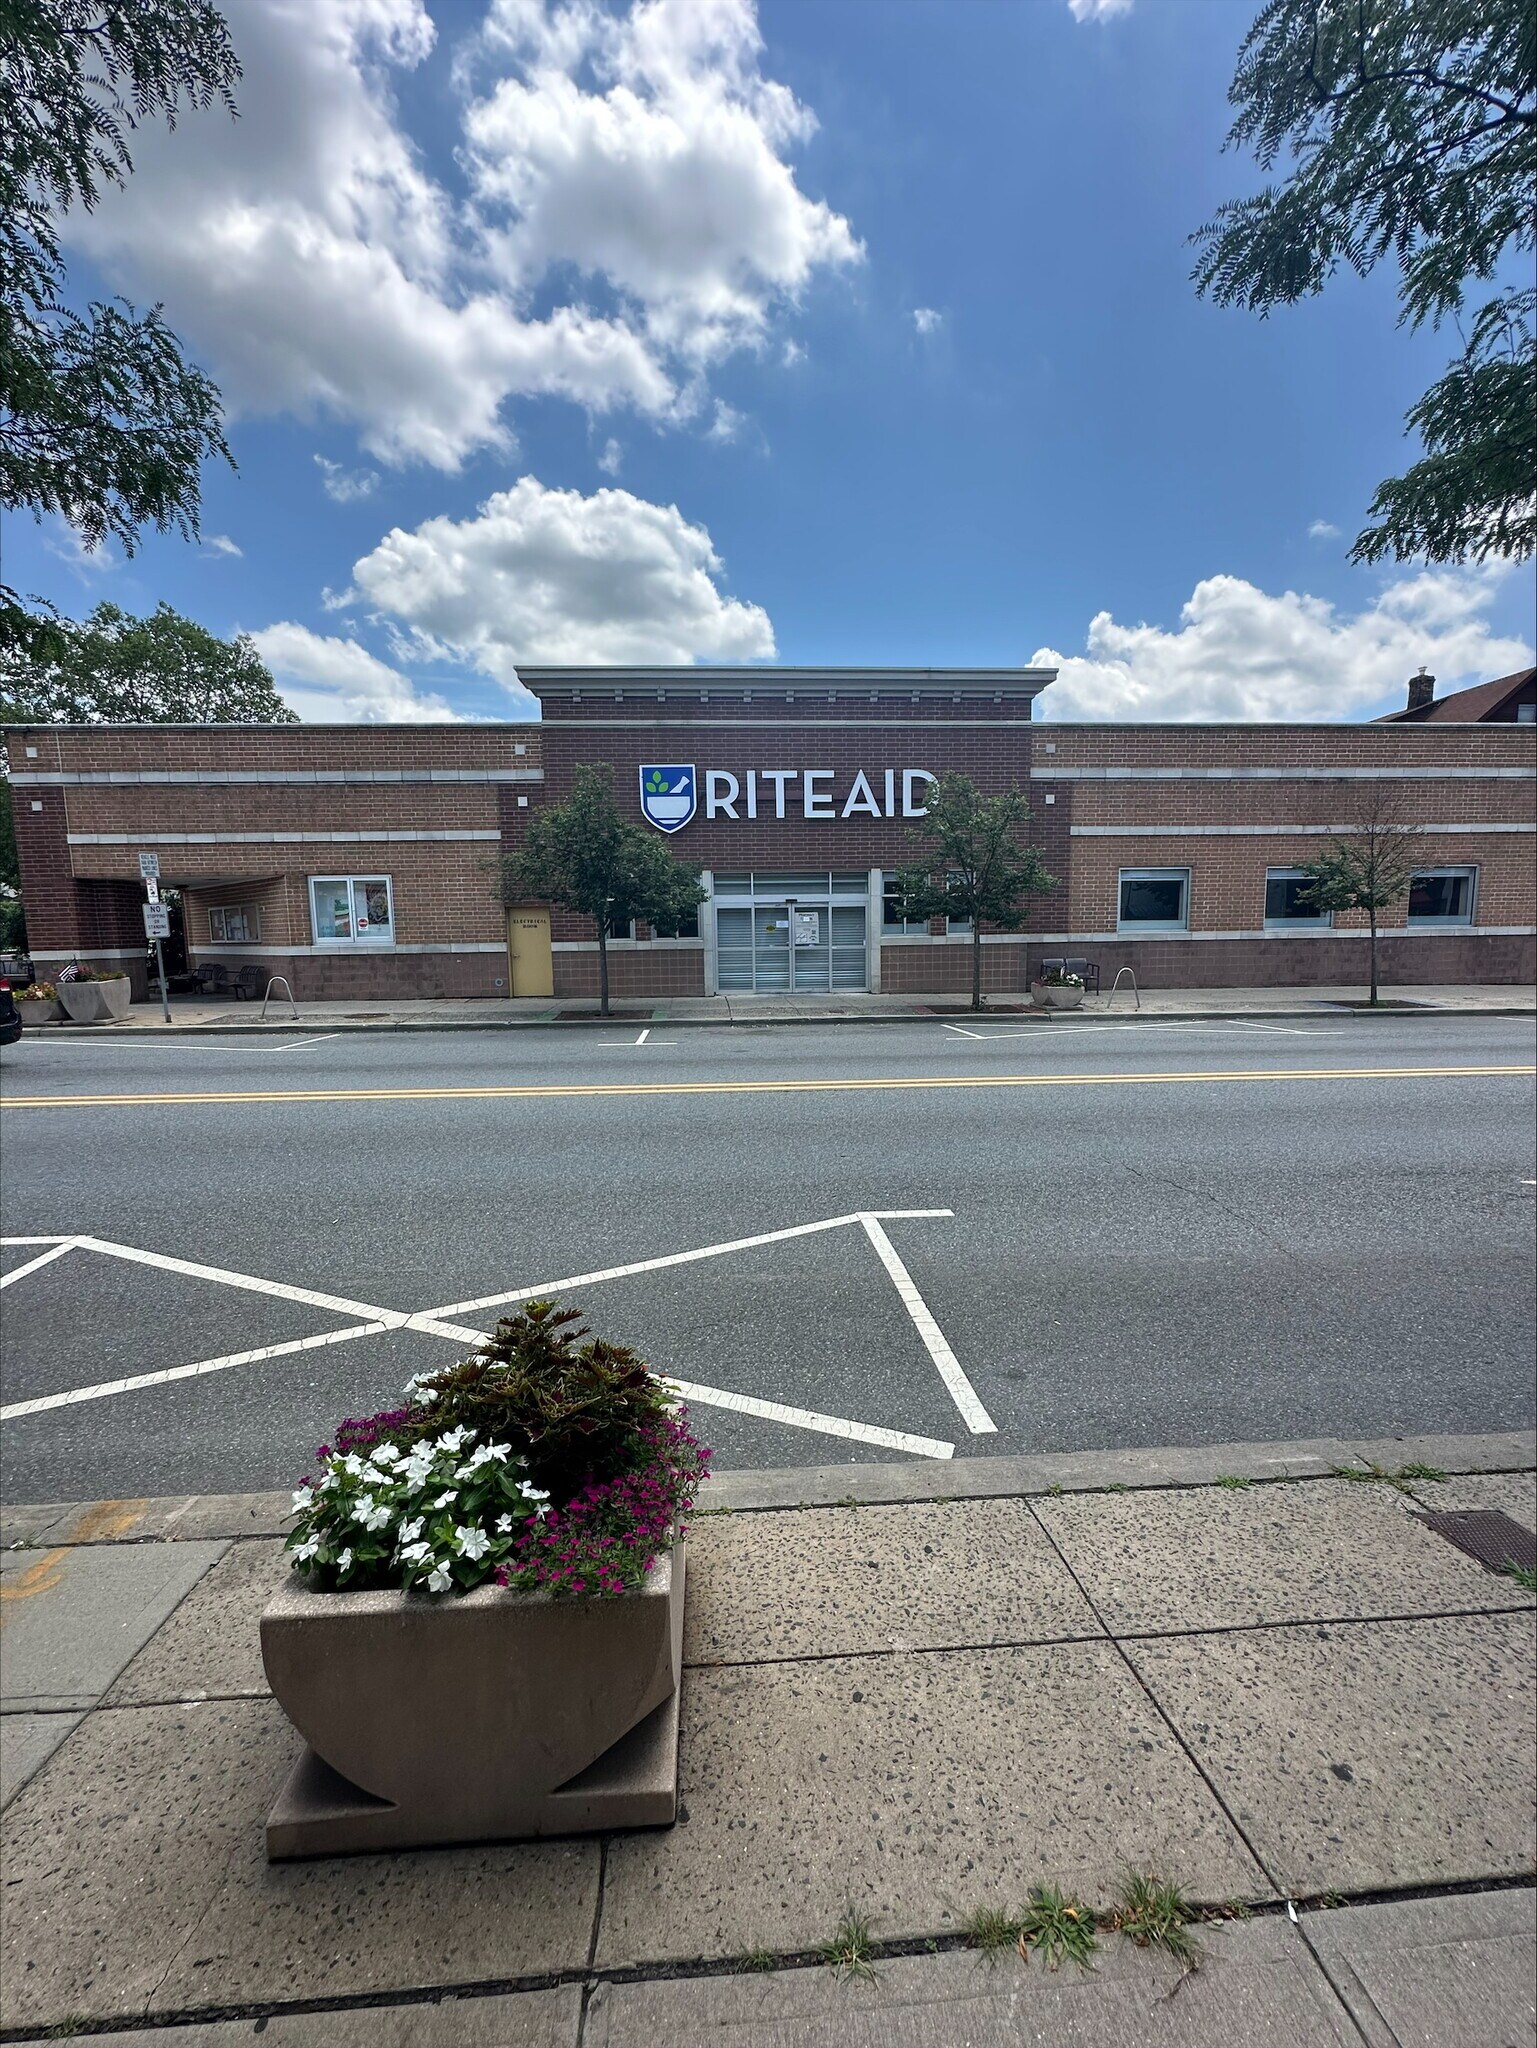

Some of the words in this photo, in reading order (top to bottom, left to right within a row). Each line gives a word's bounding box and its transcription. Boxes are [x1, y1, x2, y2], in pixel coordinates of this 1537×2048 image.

[705, 769, 836, 819] RITE
[841, 768, 940, 818] AID
[150, 905, 161, 913] NO
